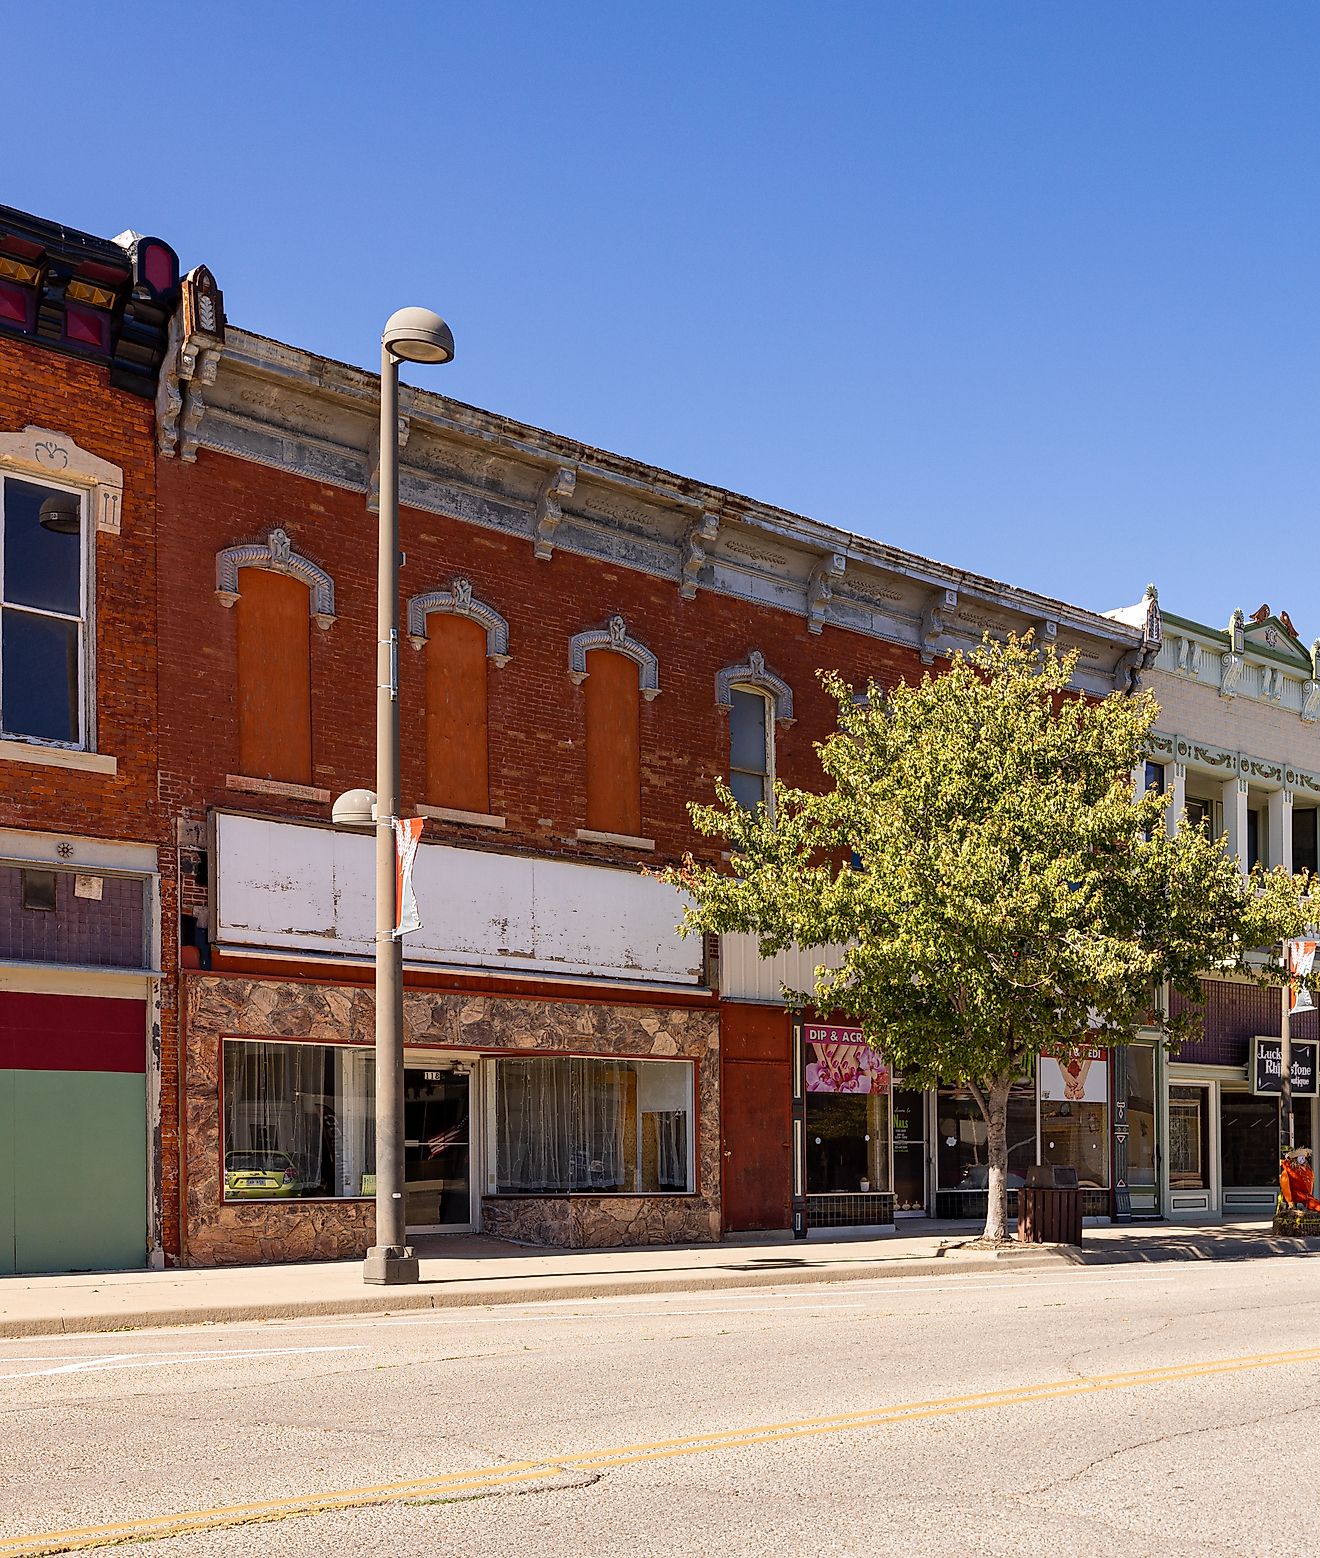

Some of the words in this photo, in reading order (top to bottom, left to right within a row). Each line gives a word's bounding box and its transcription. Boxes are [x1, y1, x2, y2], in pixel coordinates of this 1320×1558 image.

[809, 1029, 827, 1040] DIP
[830, 1030, 838, 1041] &
[1257, 1044, 1282, 1060] Luck
[426, 1072, 440, 1080] 118
